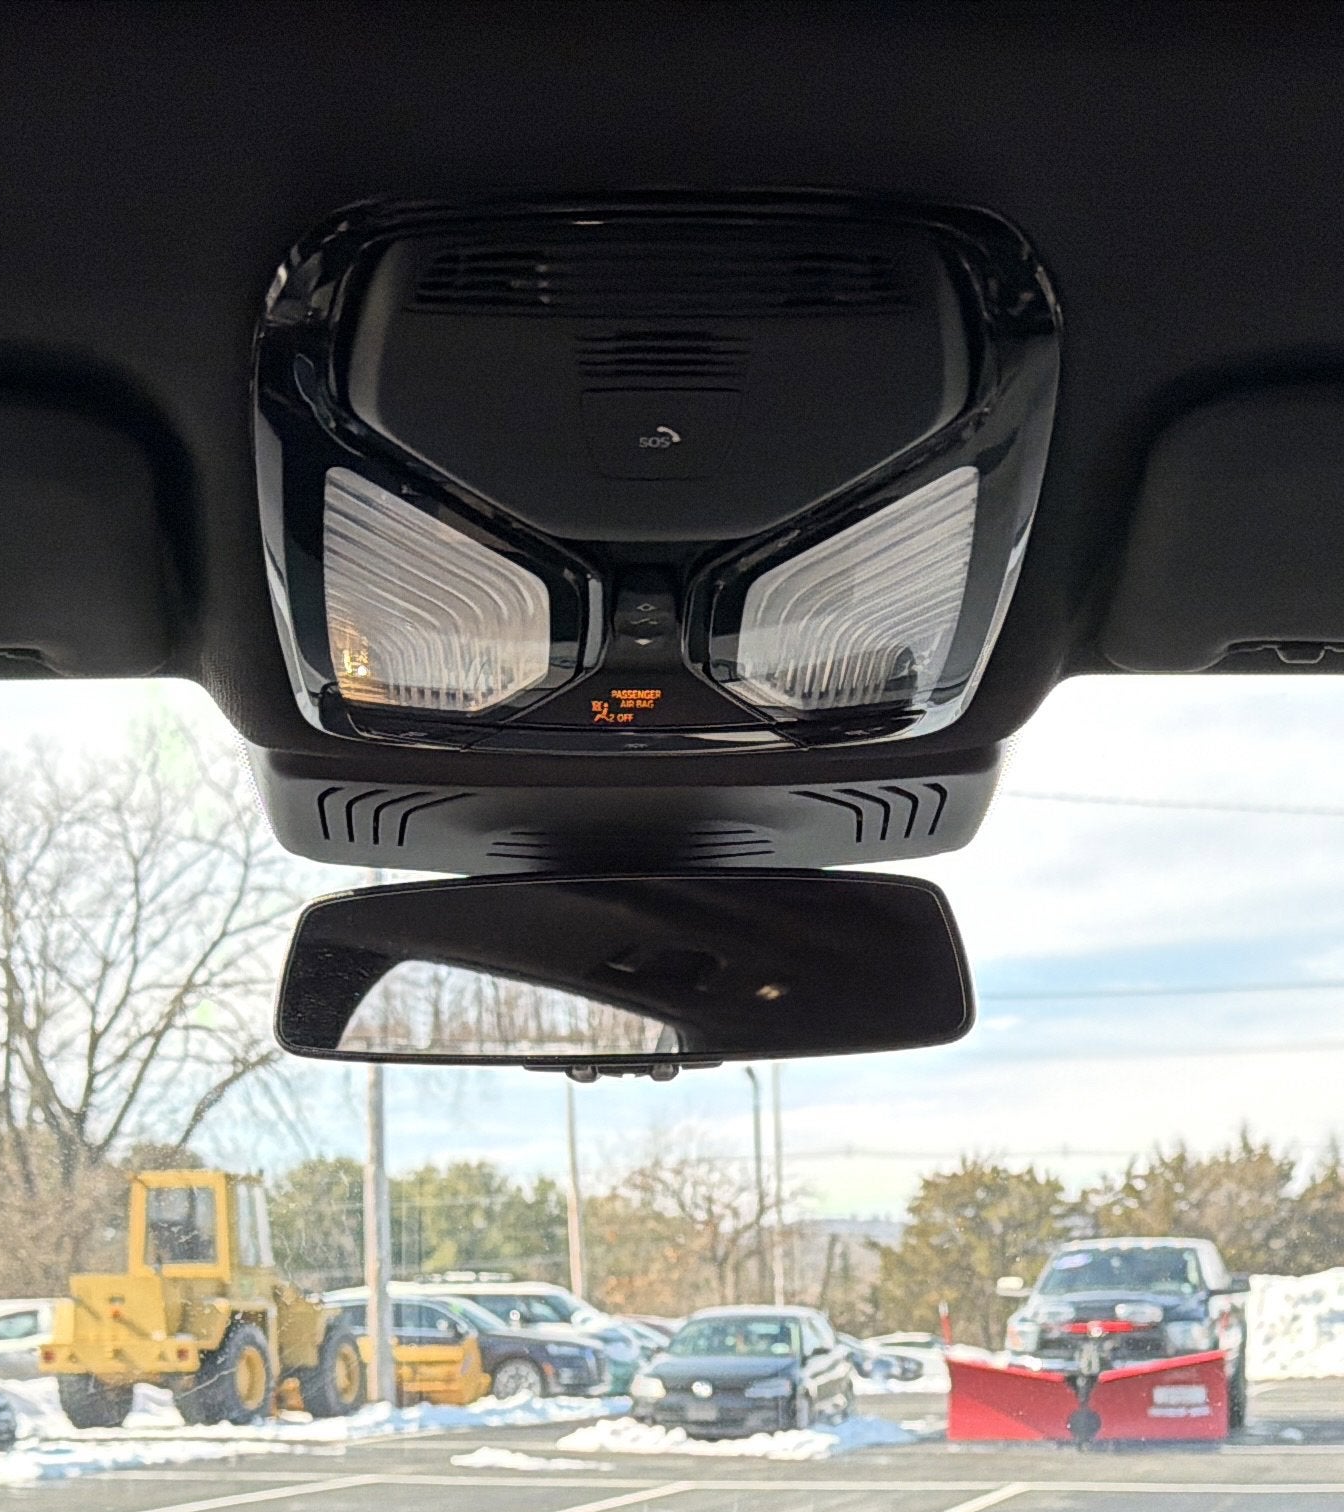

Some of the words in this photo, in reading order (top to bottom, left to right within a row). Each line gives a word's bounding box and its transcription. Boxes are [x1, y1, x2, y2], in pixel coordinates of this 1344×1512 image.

[639, 436, 672, 448] SOS
[611, 689, 662, 699] PASSENGER
[620, 699, 635, 709] AIR
[636, 699, 655, 709] BAG
[616, 713, 634, 723] OFF
